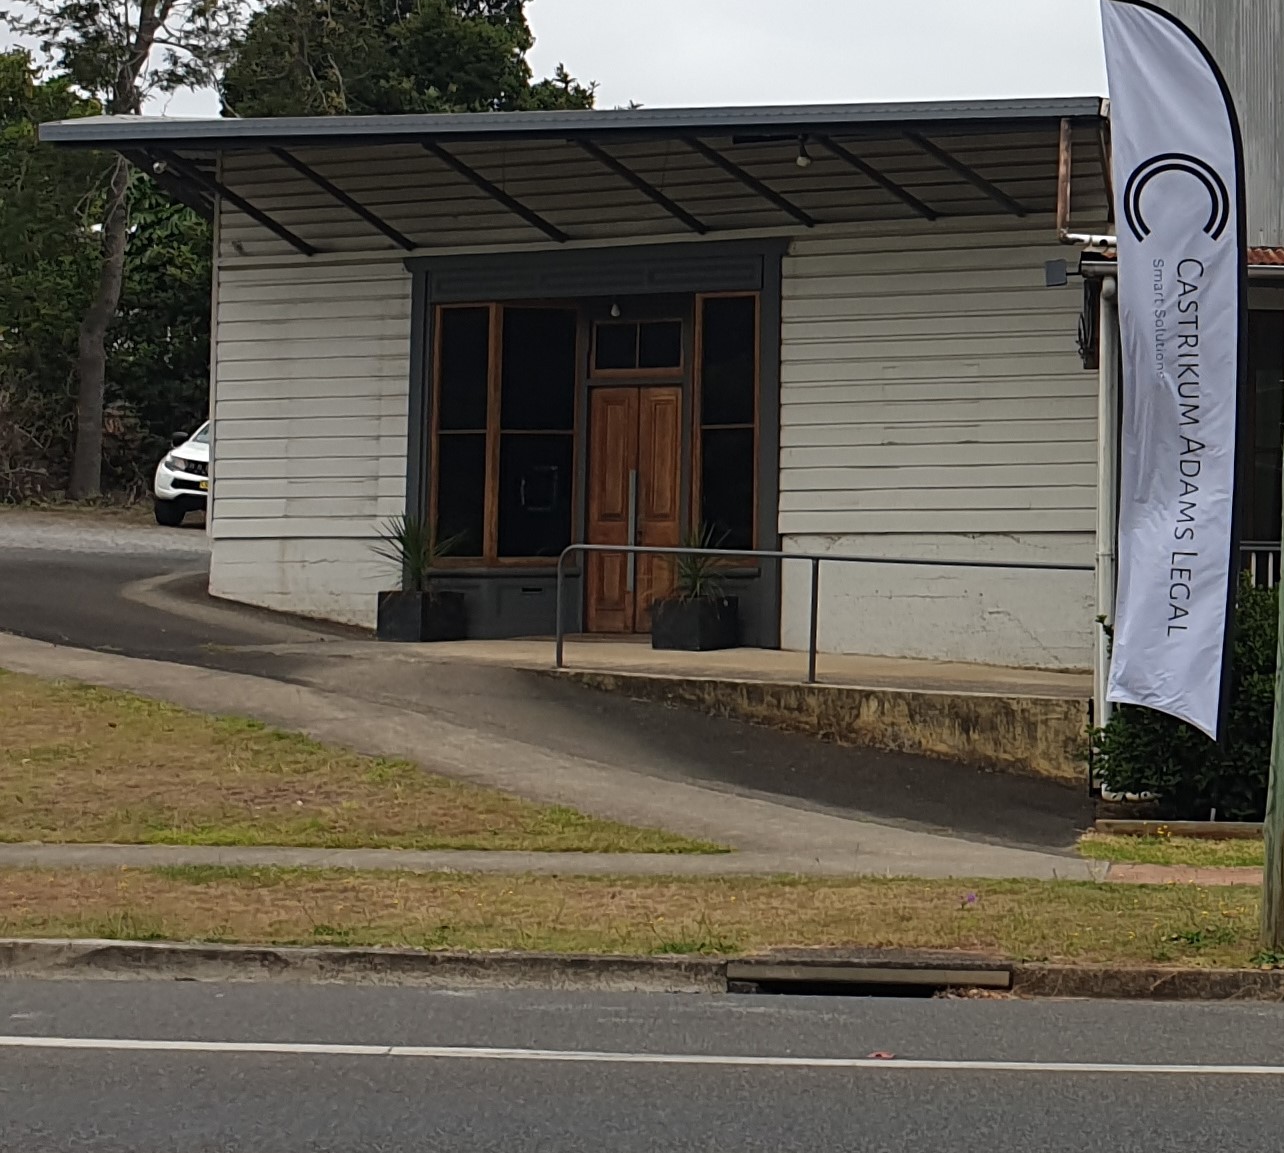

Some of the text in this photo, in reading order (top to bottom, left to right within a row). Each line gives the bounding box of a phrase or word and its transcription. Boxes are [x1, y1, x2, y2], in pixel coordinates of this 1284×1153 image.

[1152, 259, 1165, 304] Smart
[1167, 258, 1206, 637] CASTRIKUM ADAMS LEGAL
